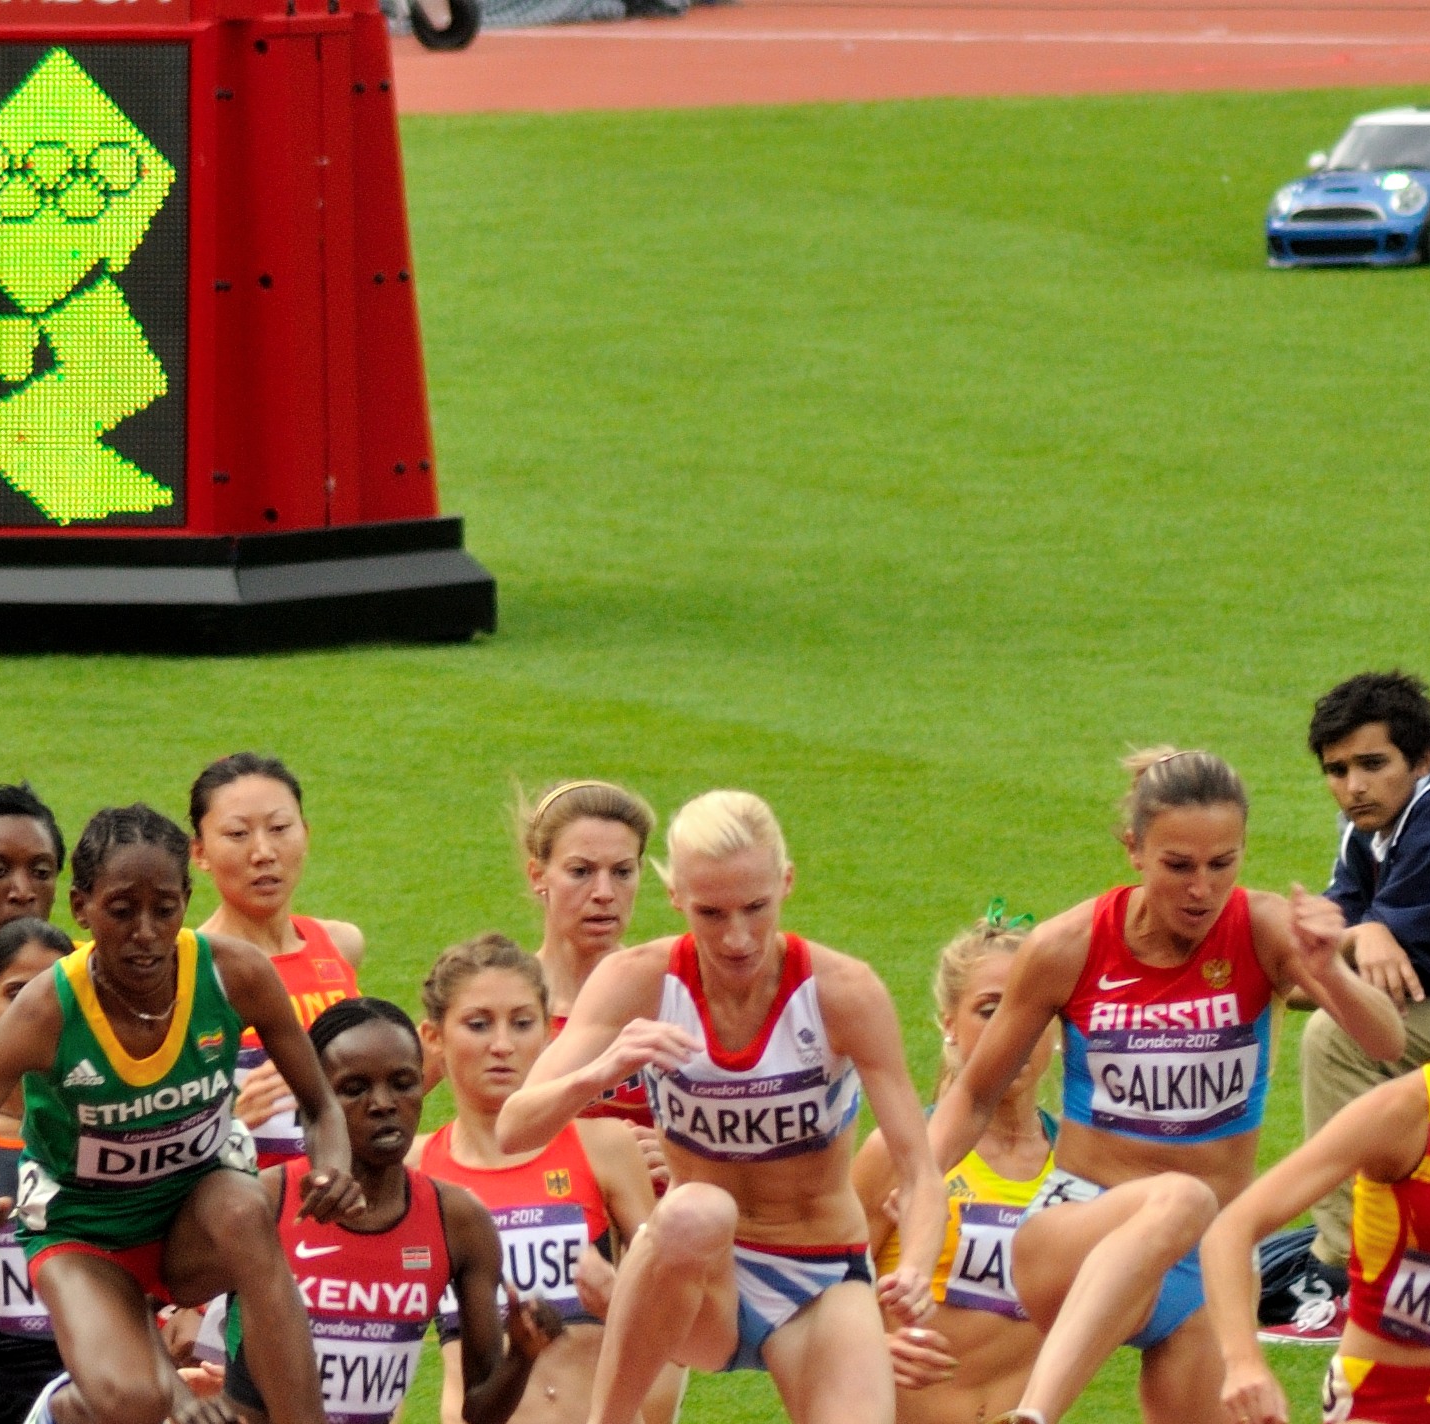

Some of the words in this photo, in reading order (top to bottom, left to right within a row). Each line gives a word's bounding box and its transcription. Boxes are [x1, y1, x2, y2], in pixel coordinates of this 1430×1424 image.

[1127, 1034, 1182, 1050] London
[1186, 1033, 1220, 1048] 2012
[78, 1069, 229, 1126] ETHIOPIA
[689, 1081, 747, 1097] London
[748, 1078, 784, 1095] 2012
[1101, 1057, 1245, 1112] GALKINA
[97, 1116, 221, 1176] DIRO
[667, 1092, 820, 1147] PARKER
[958, 1237, 1005, 1290] LA
[295, 1276, 428, 1317] KENYA
